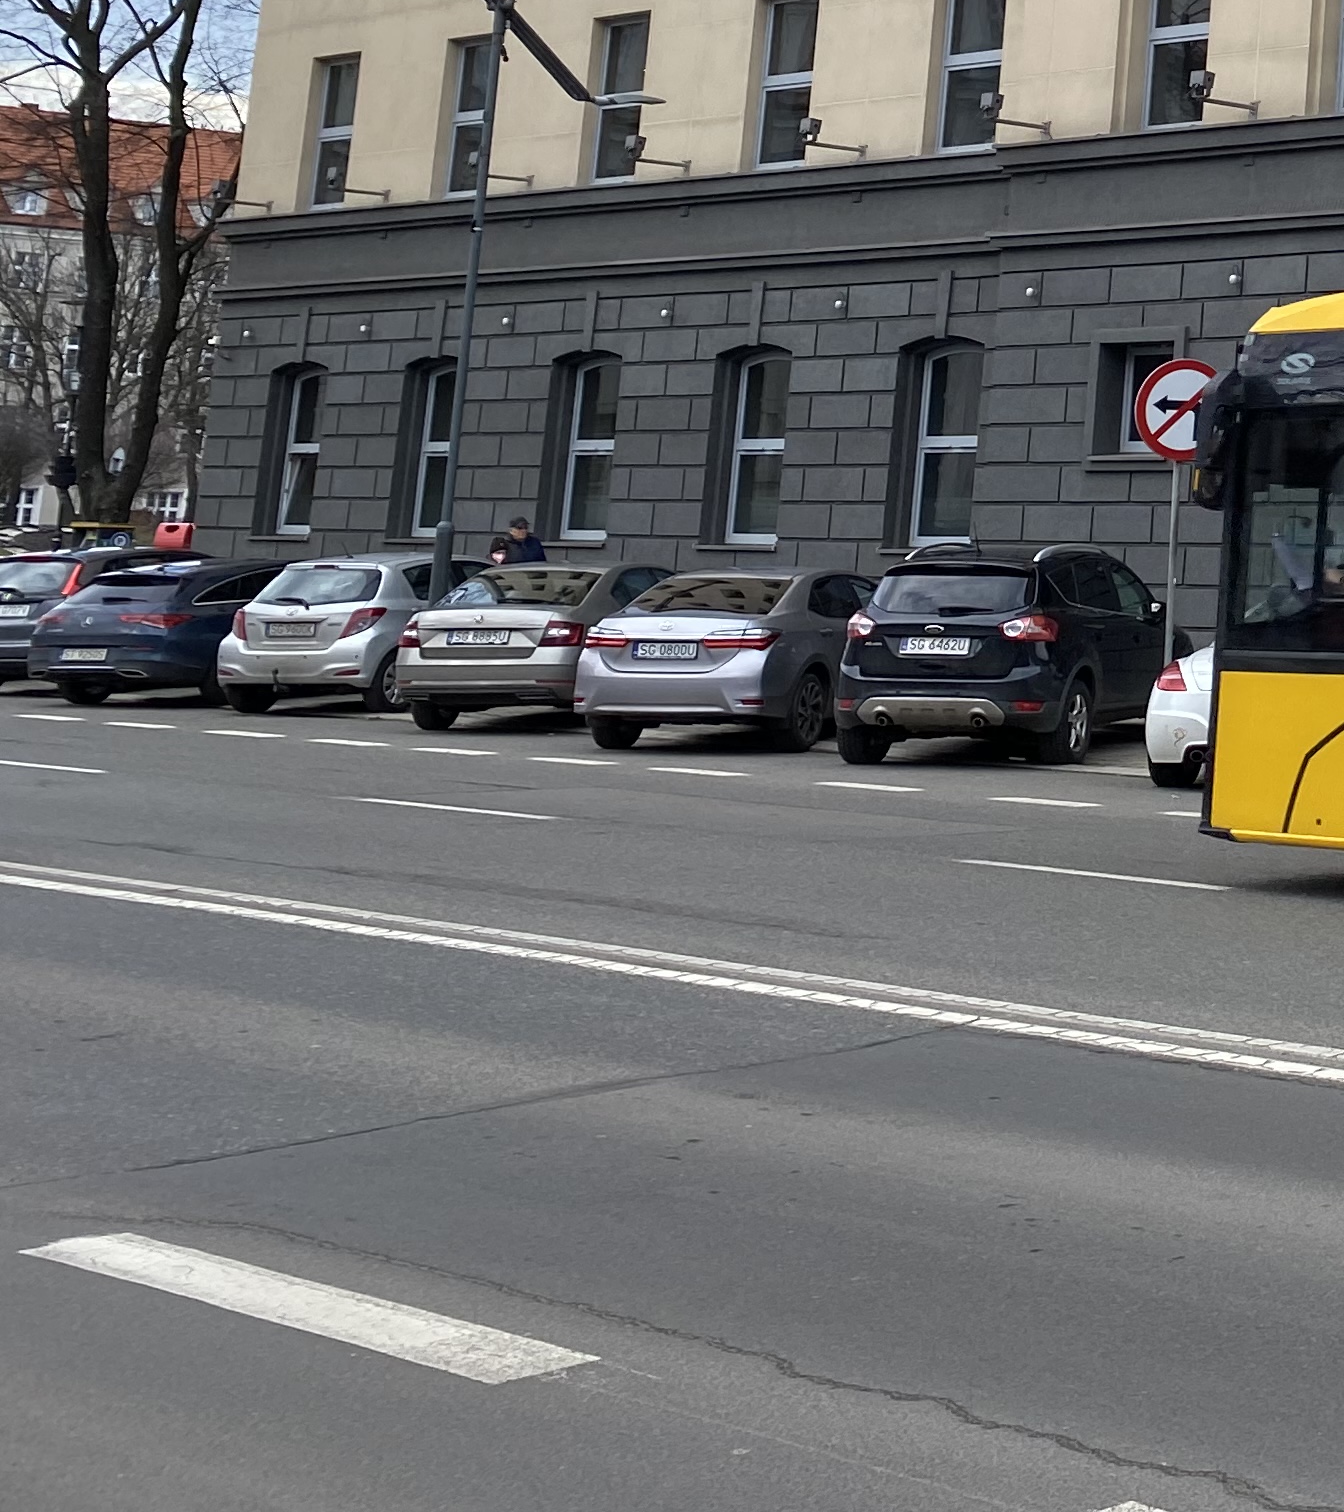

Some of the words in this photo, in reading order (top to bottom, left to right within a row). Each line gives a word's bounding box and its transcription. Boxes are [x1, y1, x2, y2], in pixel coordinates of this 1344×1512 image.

[454, 631, 469, 642] SG
[640, 644, 656, 656] SG
[909, 638, 925, 651] SG
[928, 638, 967, 651] 6462U
